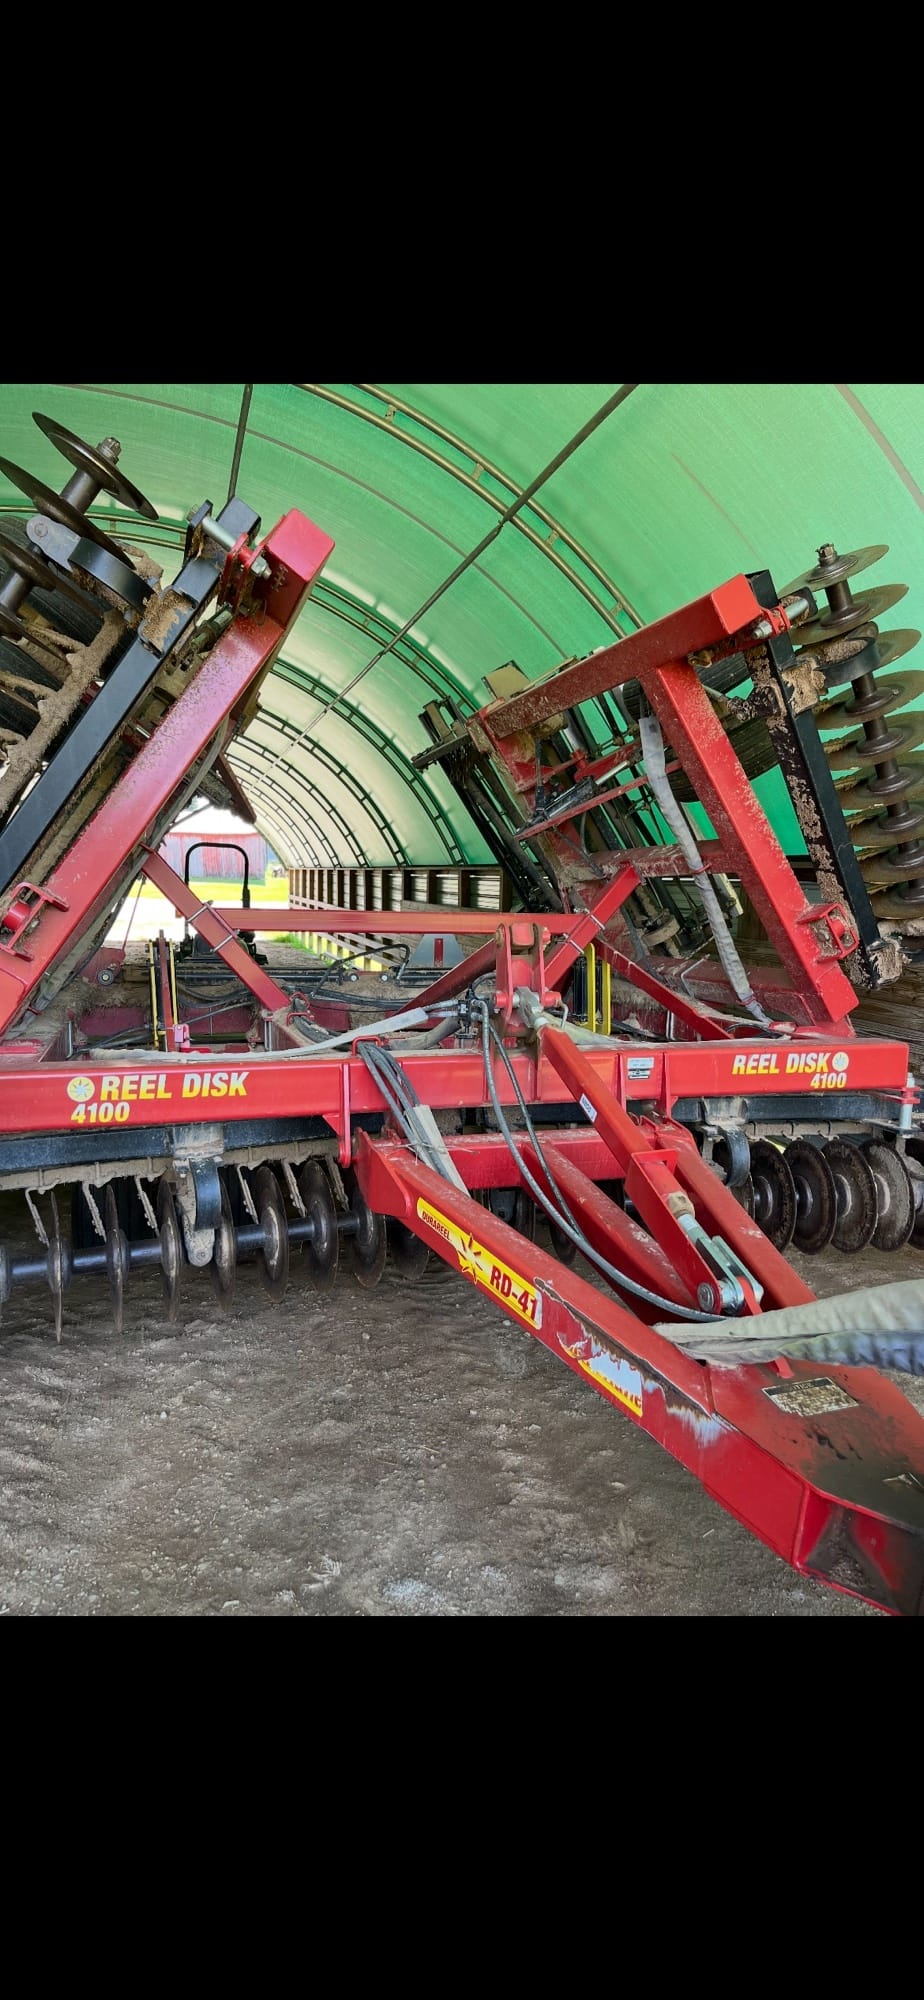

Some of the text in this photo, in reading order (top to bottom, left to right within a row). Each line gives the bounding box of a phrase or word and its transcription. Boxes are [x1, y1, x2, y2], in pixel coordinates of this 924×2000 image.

[732, 1053, 831, 1075] REEL DISK
[100, 1072, 249, 1101] REEL DISK
[810, 1073, 847, 1088] 4100
[71, 1102, 130, 1123] 4100
[421, 1210, 451, 1241] DURAREEL
[490, 1264, 537, 1320] RD-41
